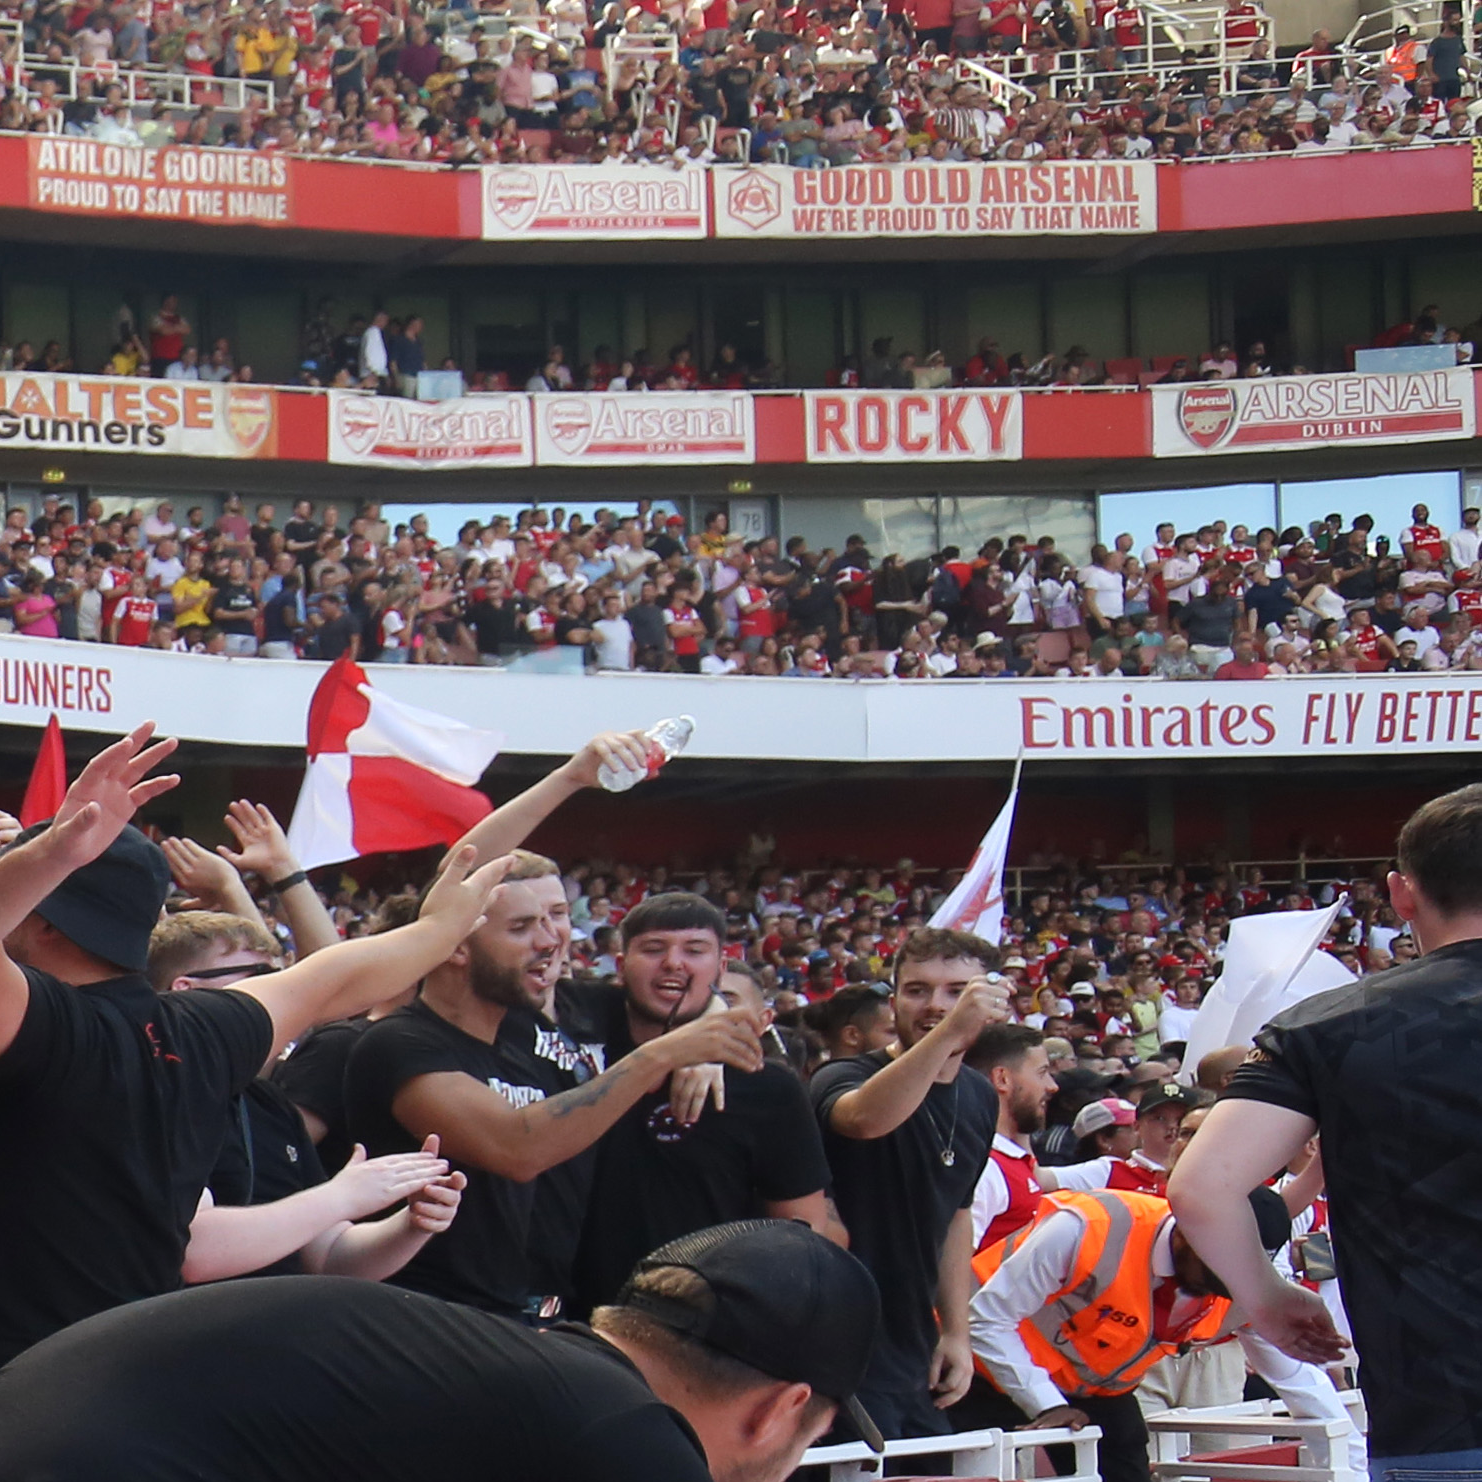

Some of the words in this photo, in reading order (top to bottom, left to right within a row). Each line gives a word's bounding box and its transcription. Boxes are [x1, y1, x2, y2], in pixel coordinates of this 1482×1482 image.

[38, 139, 157, 180] ATHLONE
[164, 151, 287, 187] GOONERS
[38, 177, 108, 207] PROUD
[112, 184, 139, 210] TO
[144, 187, 181, 214] SAY
[186, 190, 223, 215] THE
[228, 192, 287, 220] NAME
[539, 170, 700, 213] Arsenal
[793, 168, 892, 205] GOOD
[904, 168, 970, 204] OLD
[981, 165, 1138, 204] ARSENAL
[793, 208, 857, 232] WE'RE
[864, 208, 937, 231] PROUD
[946, 207, 968, 230] TO
[977, 206, 1016, 230] SAY
[1021, 206, 1072, 229] THAT
[1081, 205, 1139, 229] NAME
[592, 397, 745, 438] Arsenal
[1240, 372, 1461, 422] ARSENAL
[381, 400, 522, 442] Arsenal
[815, 396, 1011, 453] ROCKY
[1302, 421, 1382, 437] DUBLIN
[1019, 693, 1276, 749] Emirates
[1302, 692, 1365, 744] FLY
